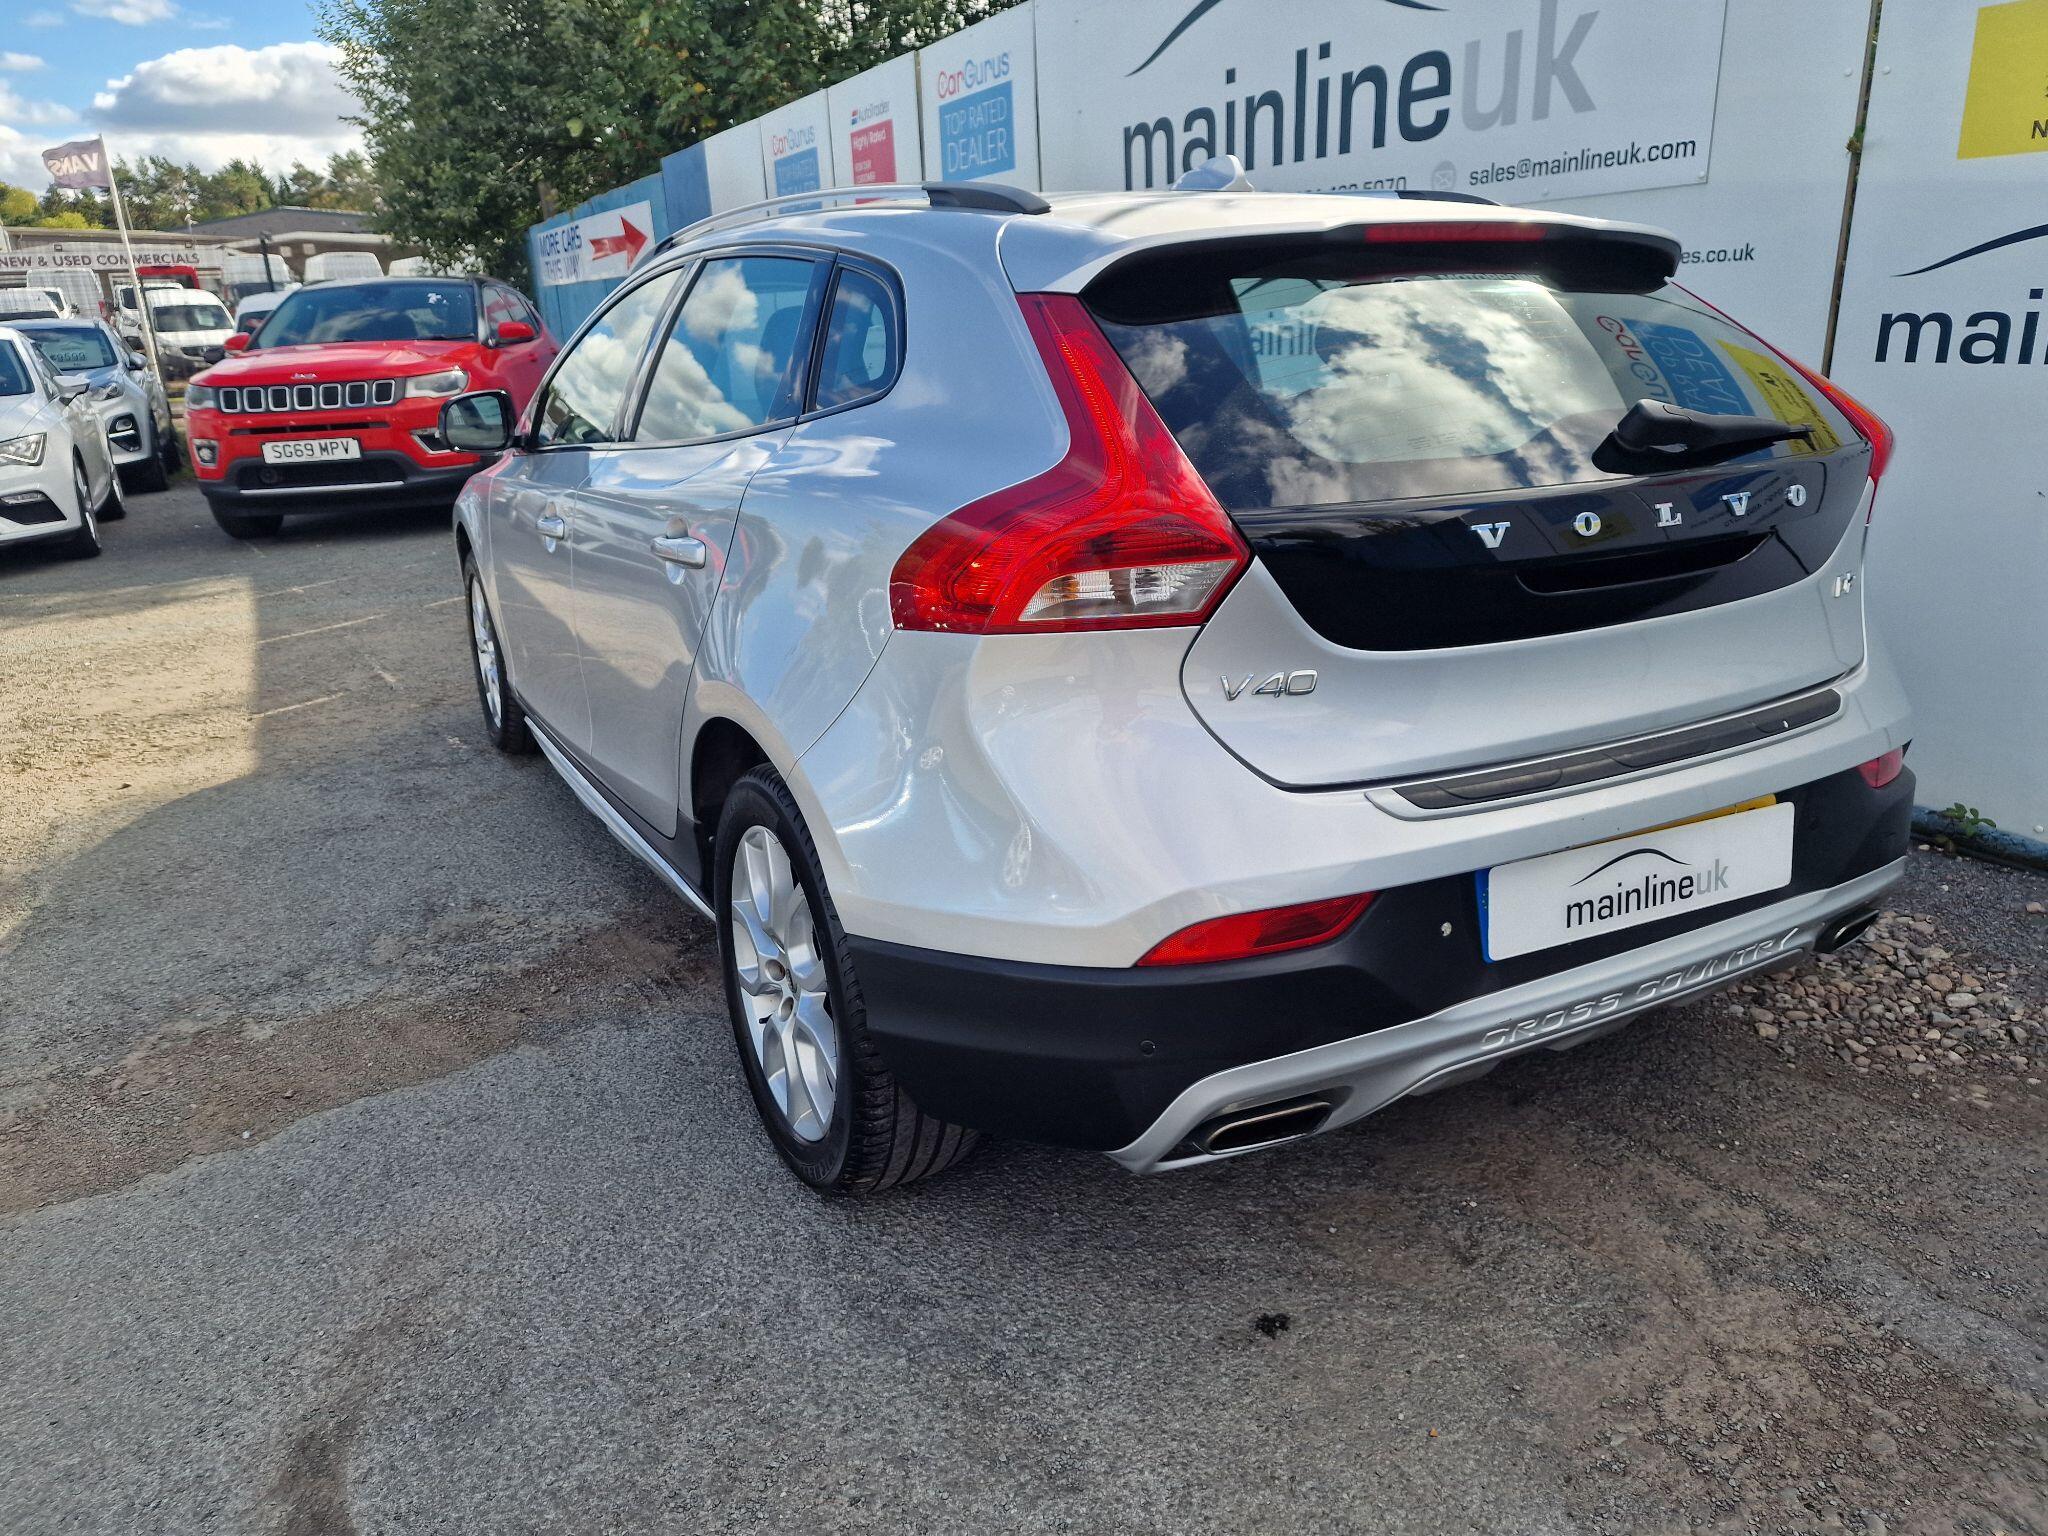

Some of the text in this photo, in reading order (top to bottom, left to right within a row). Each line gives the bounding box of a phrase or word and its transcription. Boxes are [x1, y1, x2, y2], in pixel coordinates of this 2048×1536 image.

[938, 52, 1010, 99] CarGurus
[1123, 0, 1601, 191] mainlineuk
[944, 96, 1008, 135] TOP RATED
[948, 127, 1009, 173] DEALER
[1468, 138, 1697, 187] sales@mainlineuk.com
[0, 253, 200, 268] NEW & USED COMMERCIALS
[539, 224, 583, 257] MORE CARS
[1681, 242, 1755, 264] es.co.uk
[1875, 288, 2048, 365] mai
[271, 440, 350, 459] SG69 MPV
[1470, 484, 1807, 549] VOLVO
[1220, 669, 1318, 701] V40
[1566, 858, 1729, 929] mainlineuk
[1481, 927, 1800, 1049] CROSS COUNTRY
